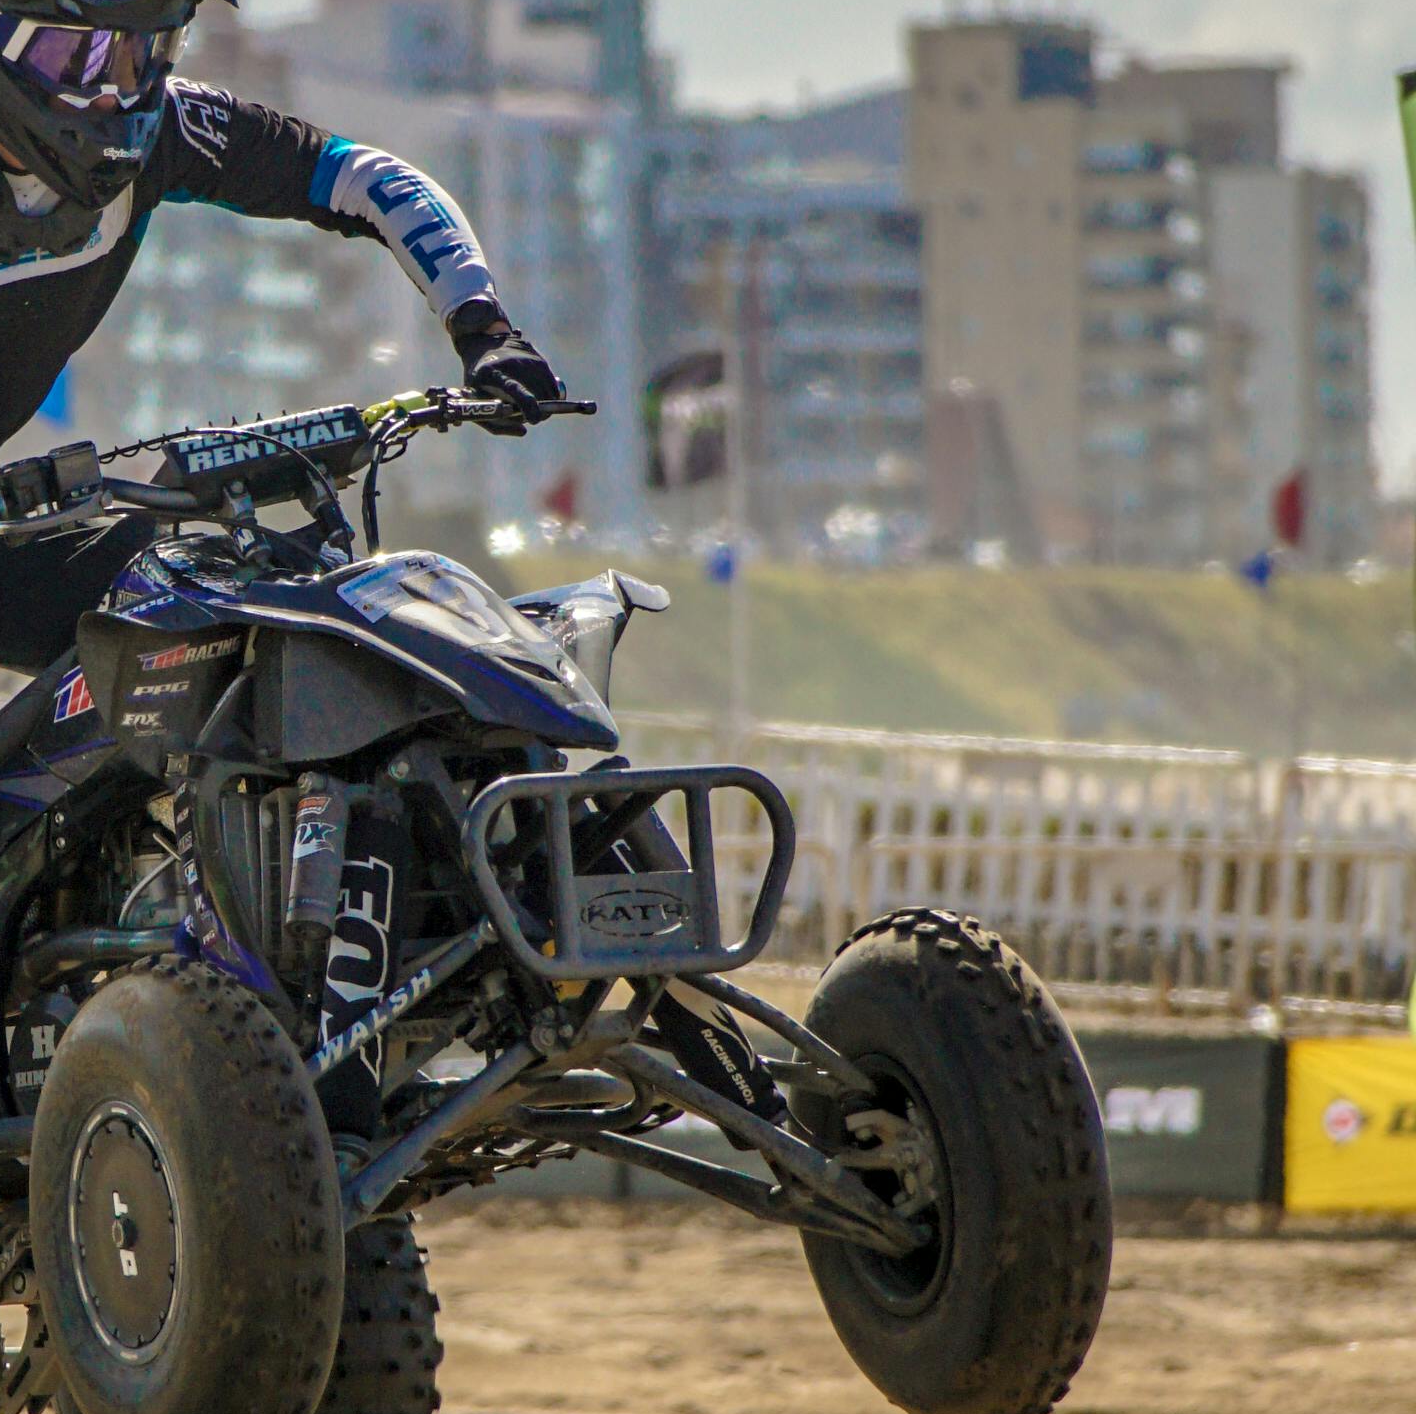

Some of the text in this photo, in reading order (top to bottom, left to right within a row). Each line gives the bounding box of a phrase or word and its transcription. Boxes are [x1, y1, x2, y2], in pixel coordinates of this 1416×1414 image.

[187, 420, 356, 474] RENTHAL
[122, 713, 163, 728] FOX
[133, 681, 190, 696] PPG
[317, 967, 433, 1071] WALSH
[701, 1027, 755, 1106] RACING SHOX
[112, 1190, 138, 1277] DT
